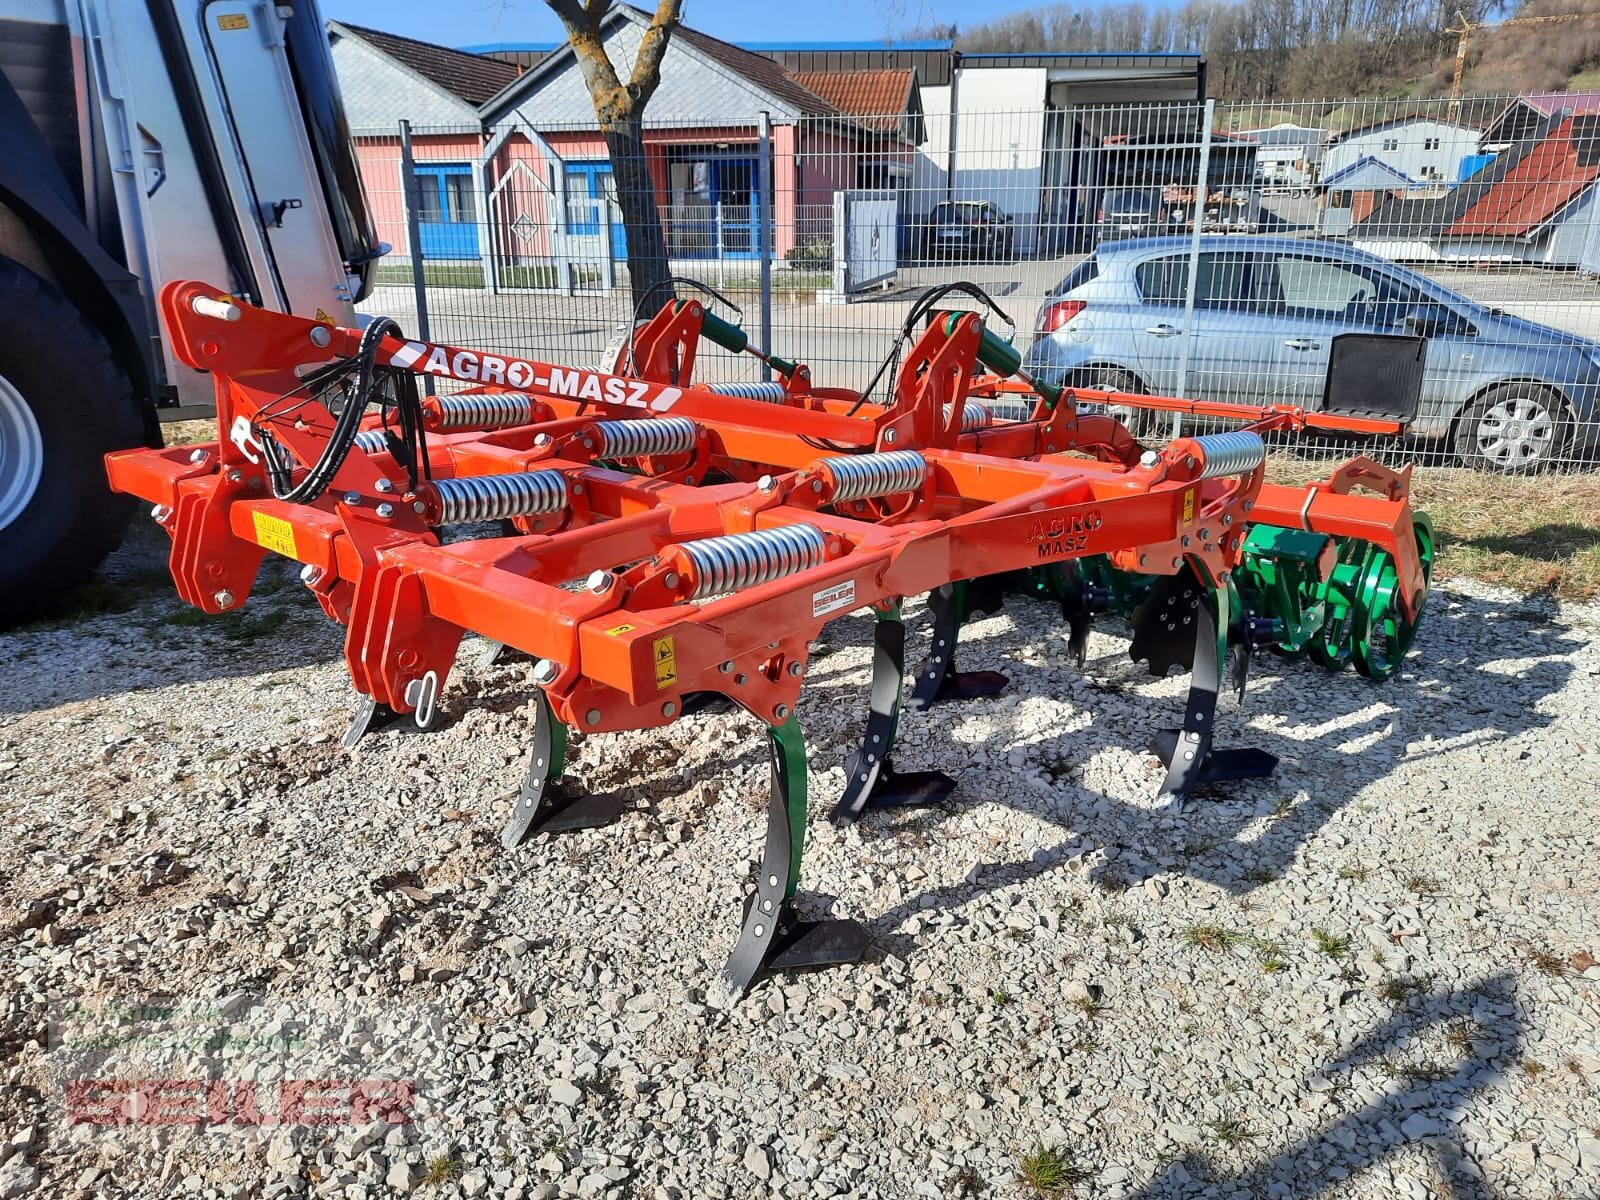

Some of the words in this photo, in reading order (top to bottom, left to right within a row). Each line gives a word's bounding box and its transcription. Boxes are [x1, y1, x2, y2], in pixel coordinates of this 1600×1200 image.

[424, 347, 649, 408] AGRO-MASZ
[1026, 509, 1103, 543] AGRO
[1037, 535, 1087, 558] MASZ
[814, 587, 855, 608] SEILER
